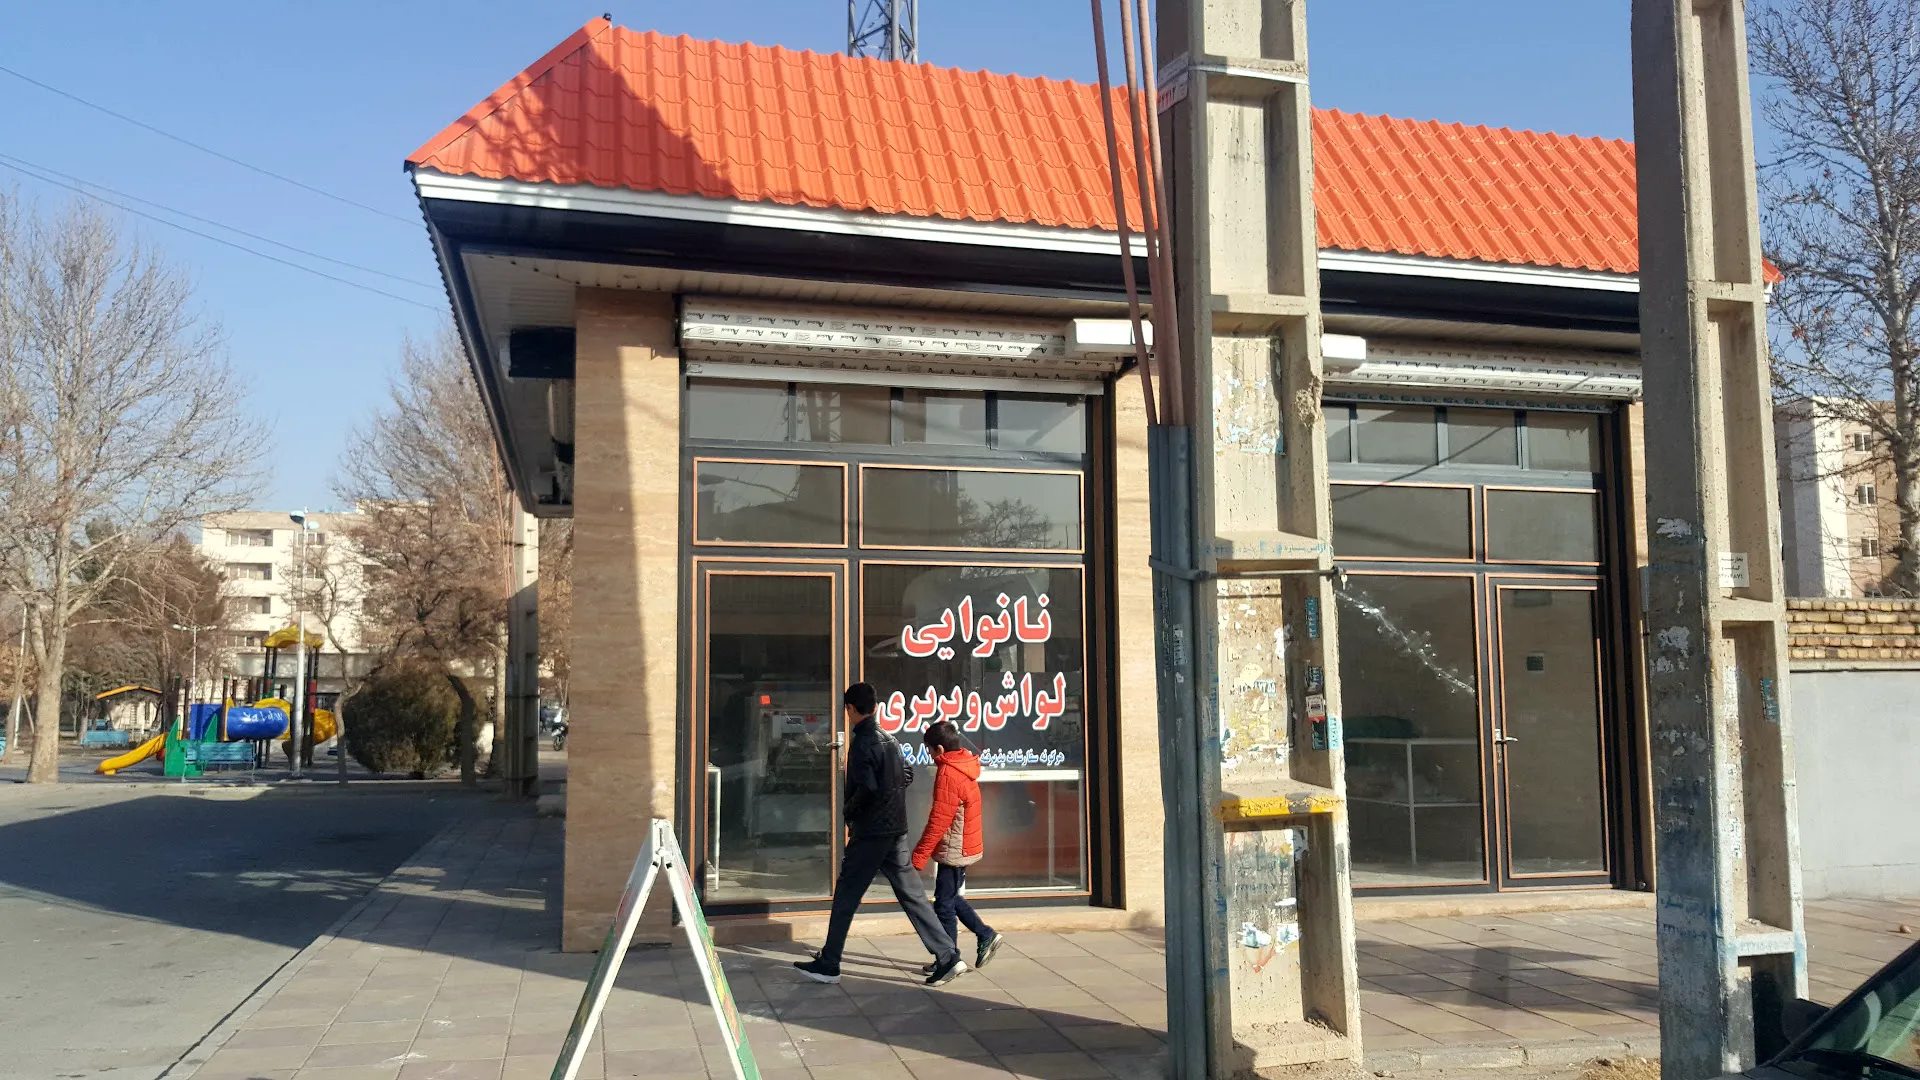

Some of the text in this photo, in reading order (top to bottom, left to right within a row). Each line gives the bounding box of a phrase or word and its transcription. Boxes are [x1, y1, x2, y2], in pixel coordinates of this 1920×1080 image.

[902, 592, 1052, 660] نانوایی
[877, 671, 1066, 733] لواش و بربری
[1006, 748, 1039, 766] سفارشات
